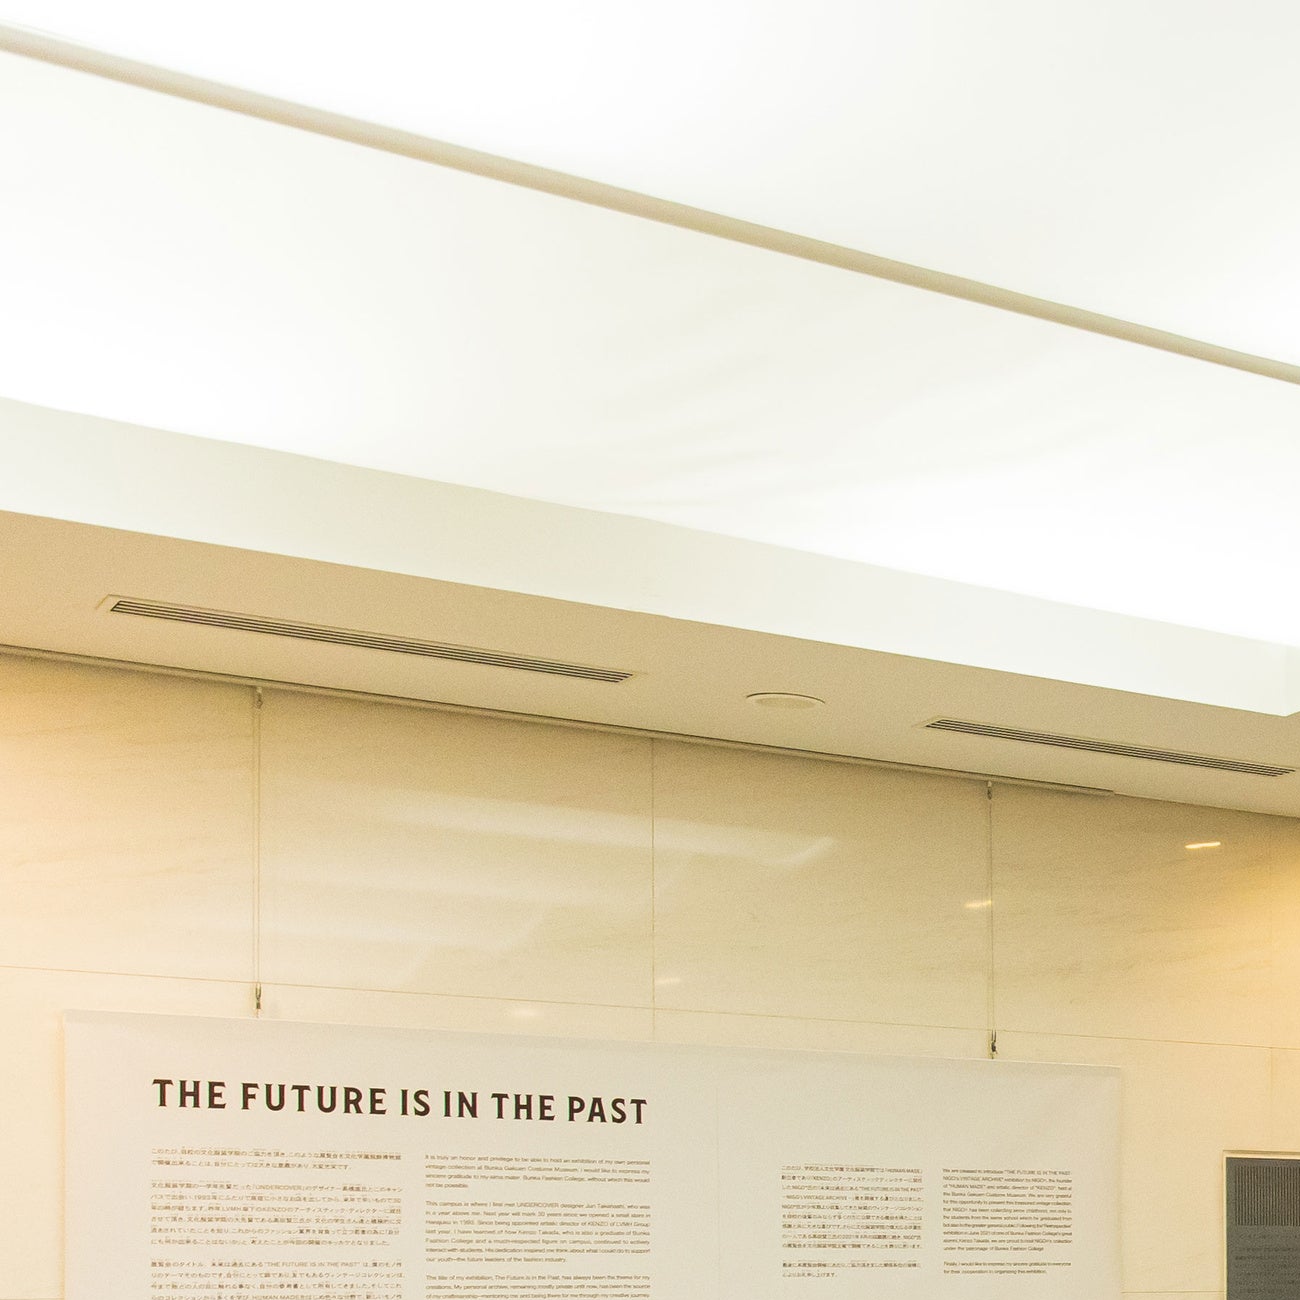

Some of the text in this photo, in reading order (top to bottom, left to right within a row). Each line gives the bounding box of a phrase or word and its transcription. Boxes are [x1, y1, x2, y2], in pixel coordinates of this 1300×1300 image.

[153, 1079, 648, 1125] THE FUTURE IS IN THE PAST
